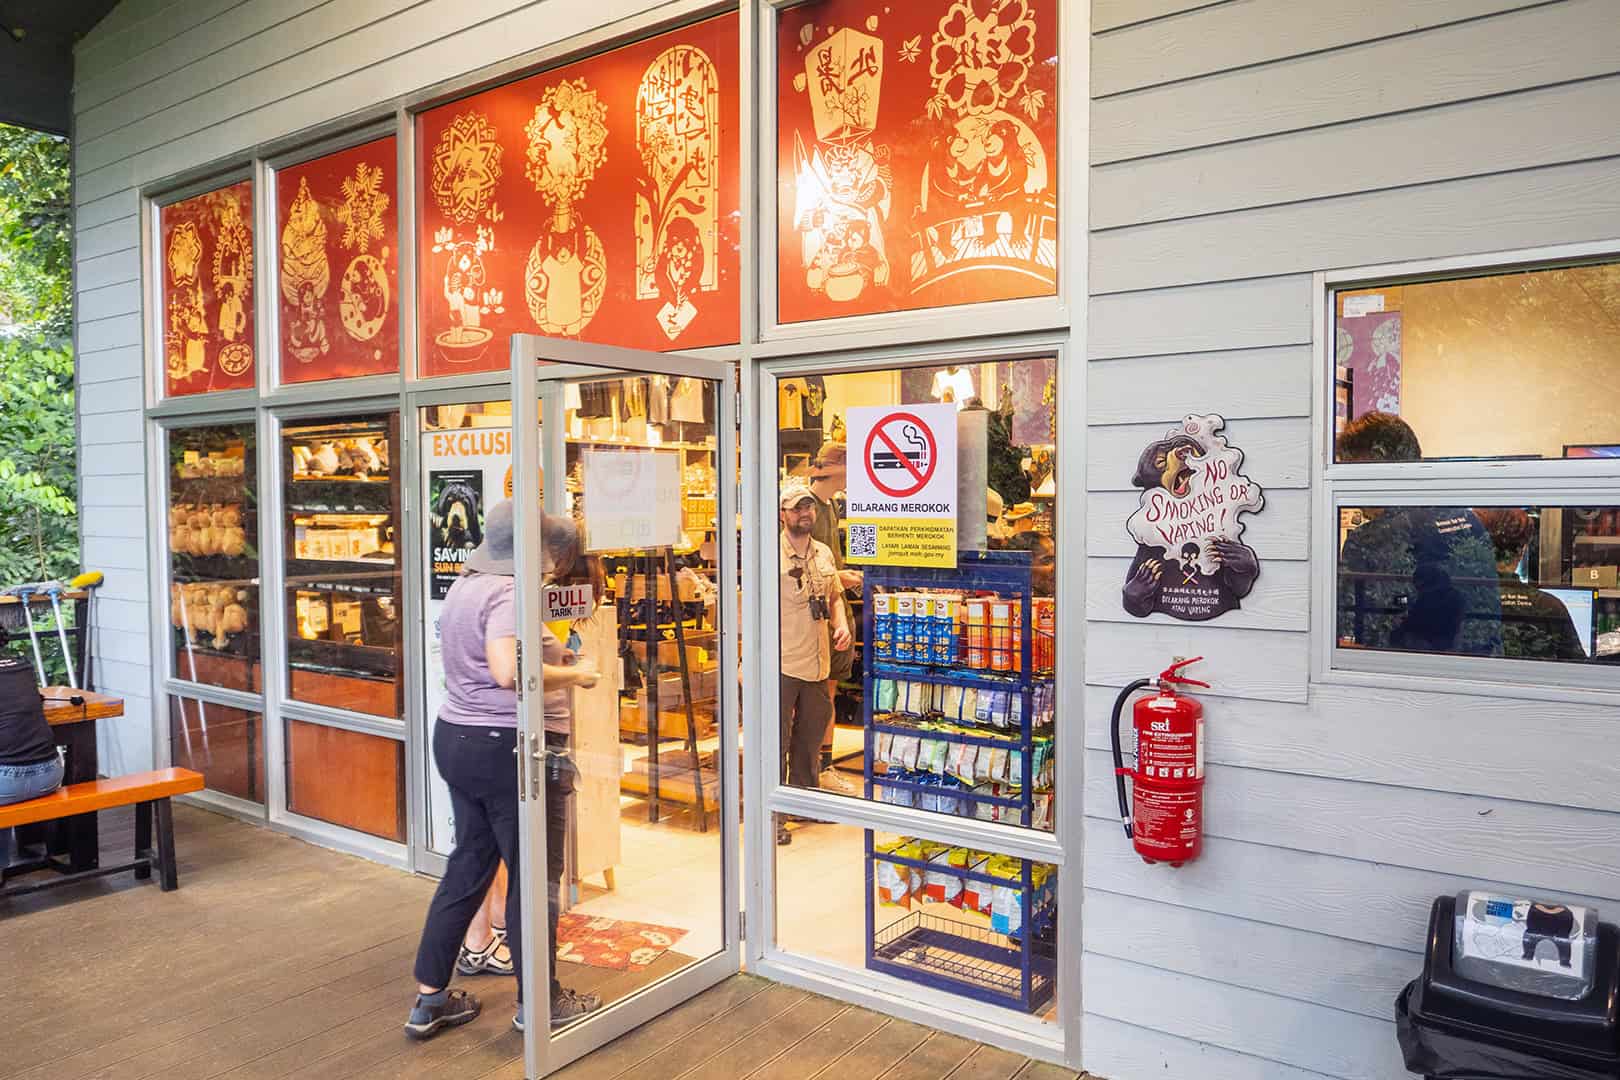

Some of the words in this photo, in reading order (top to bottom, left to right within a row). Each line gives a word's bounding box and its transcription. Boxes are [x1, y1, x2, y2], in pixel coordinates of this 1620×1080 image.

[433, 431, 511, 457] EXCLUSI
[1204, 460, 1228, 487] NO
[851, 503, 898, 512] DILARANG
[900, 503, 951, 513] MEROKOK
[1146, 486, 1224, 522] SMOKING
[1230, 484, 1249, 501] OR
[1590, 569, 1599, 580] B
[548, 589, 586, 608] PULL
